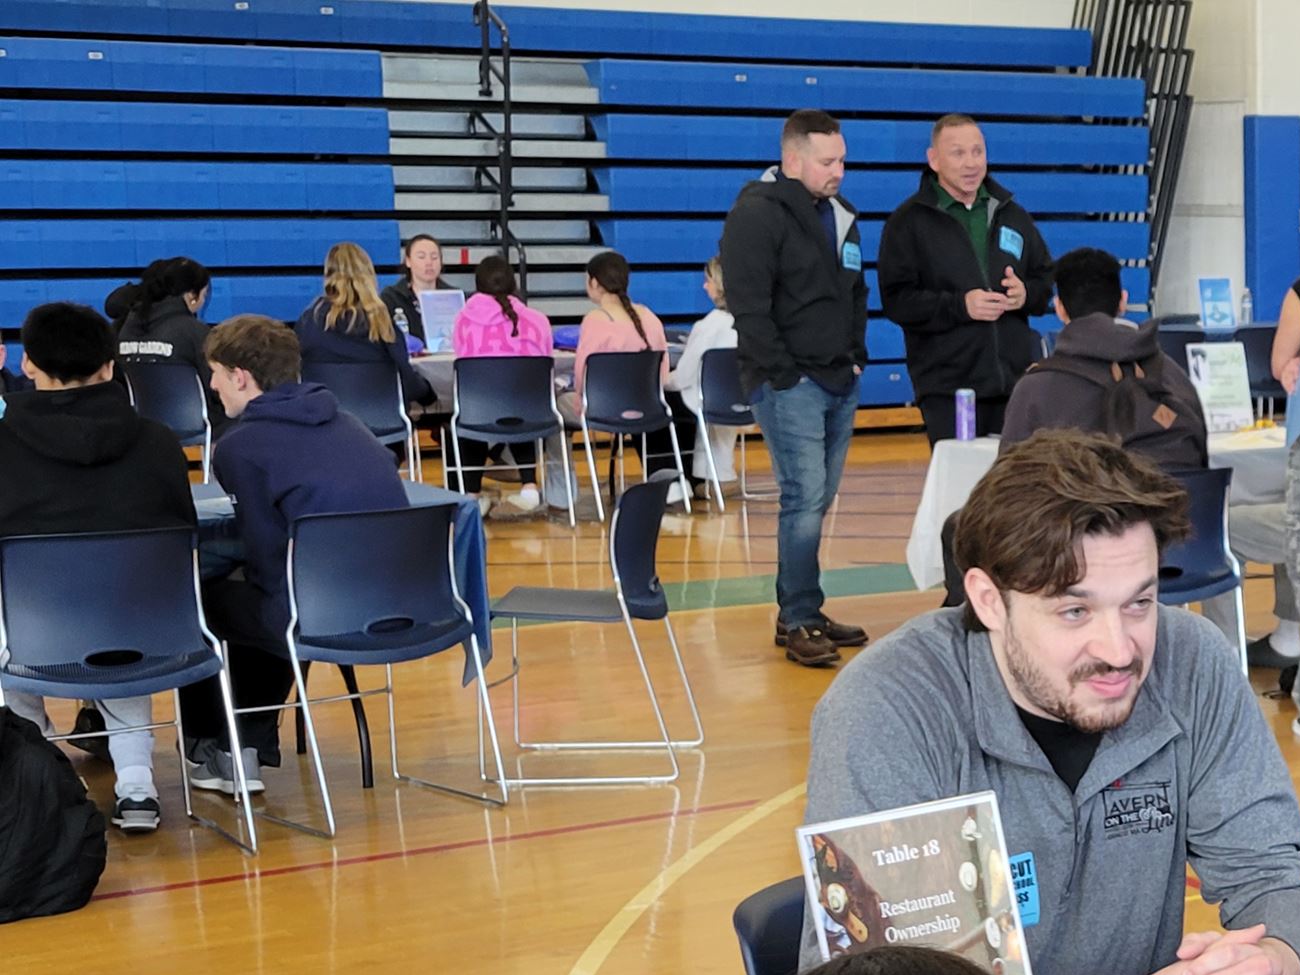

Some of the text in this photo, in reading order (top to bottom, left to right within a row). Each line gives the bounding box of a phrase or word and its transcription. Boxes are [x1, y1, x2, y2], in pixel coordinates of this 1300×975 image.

[1105, 815, 1120, 827] ON
[1120, 813, 1139, 824] THE
[872, 839, 941, 866] Table 18
[879, 889, 956, 918] Restaurant
[885, 913, 960, 943] Ownership
